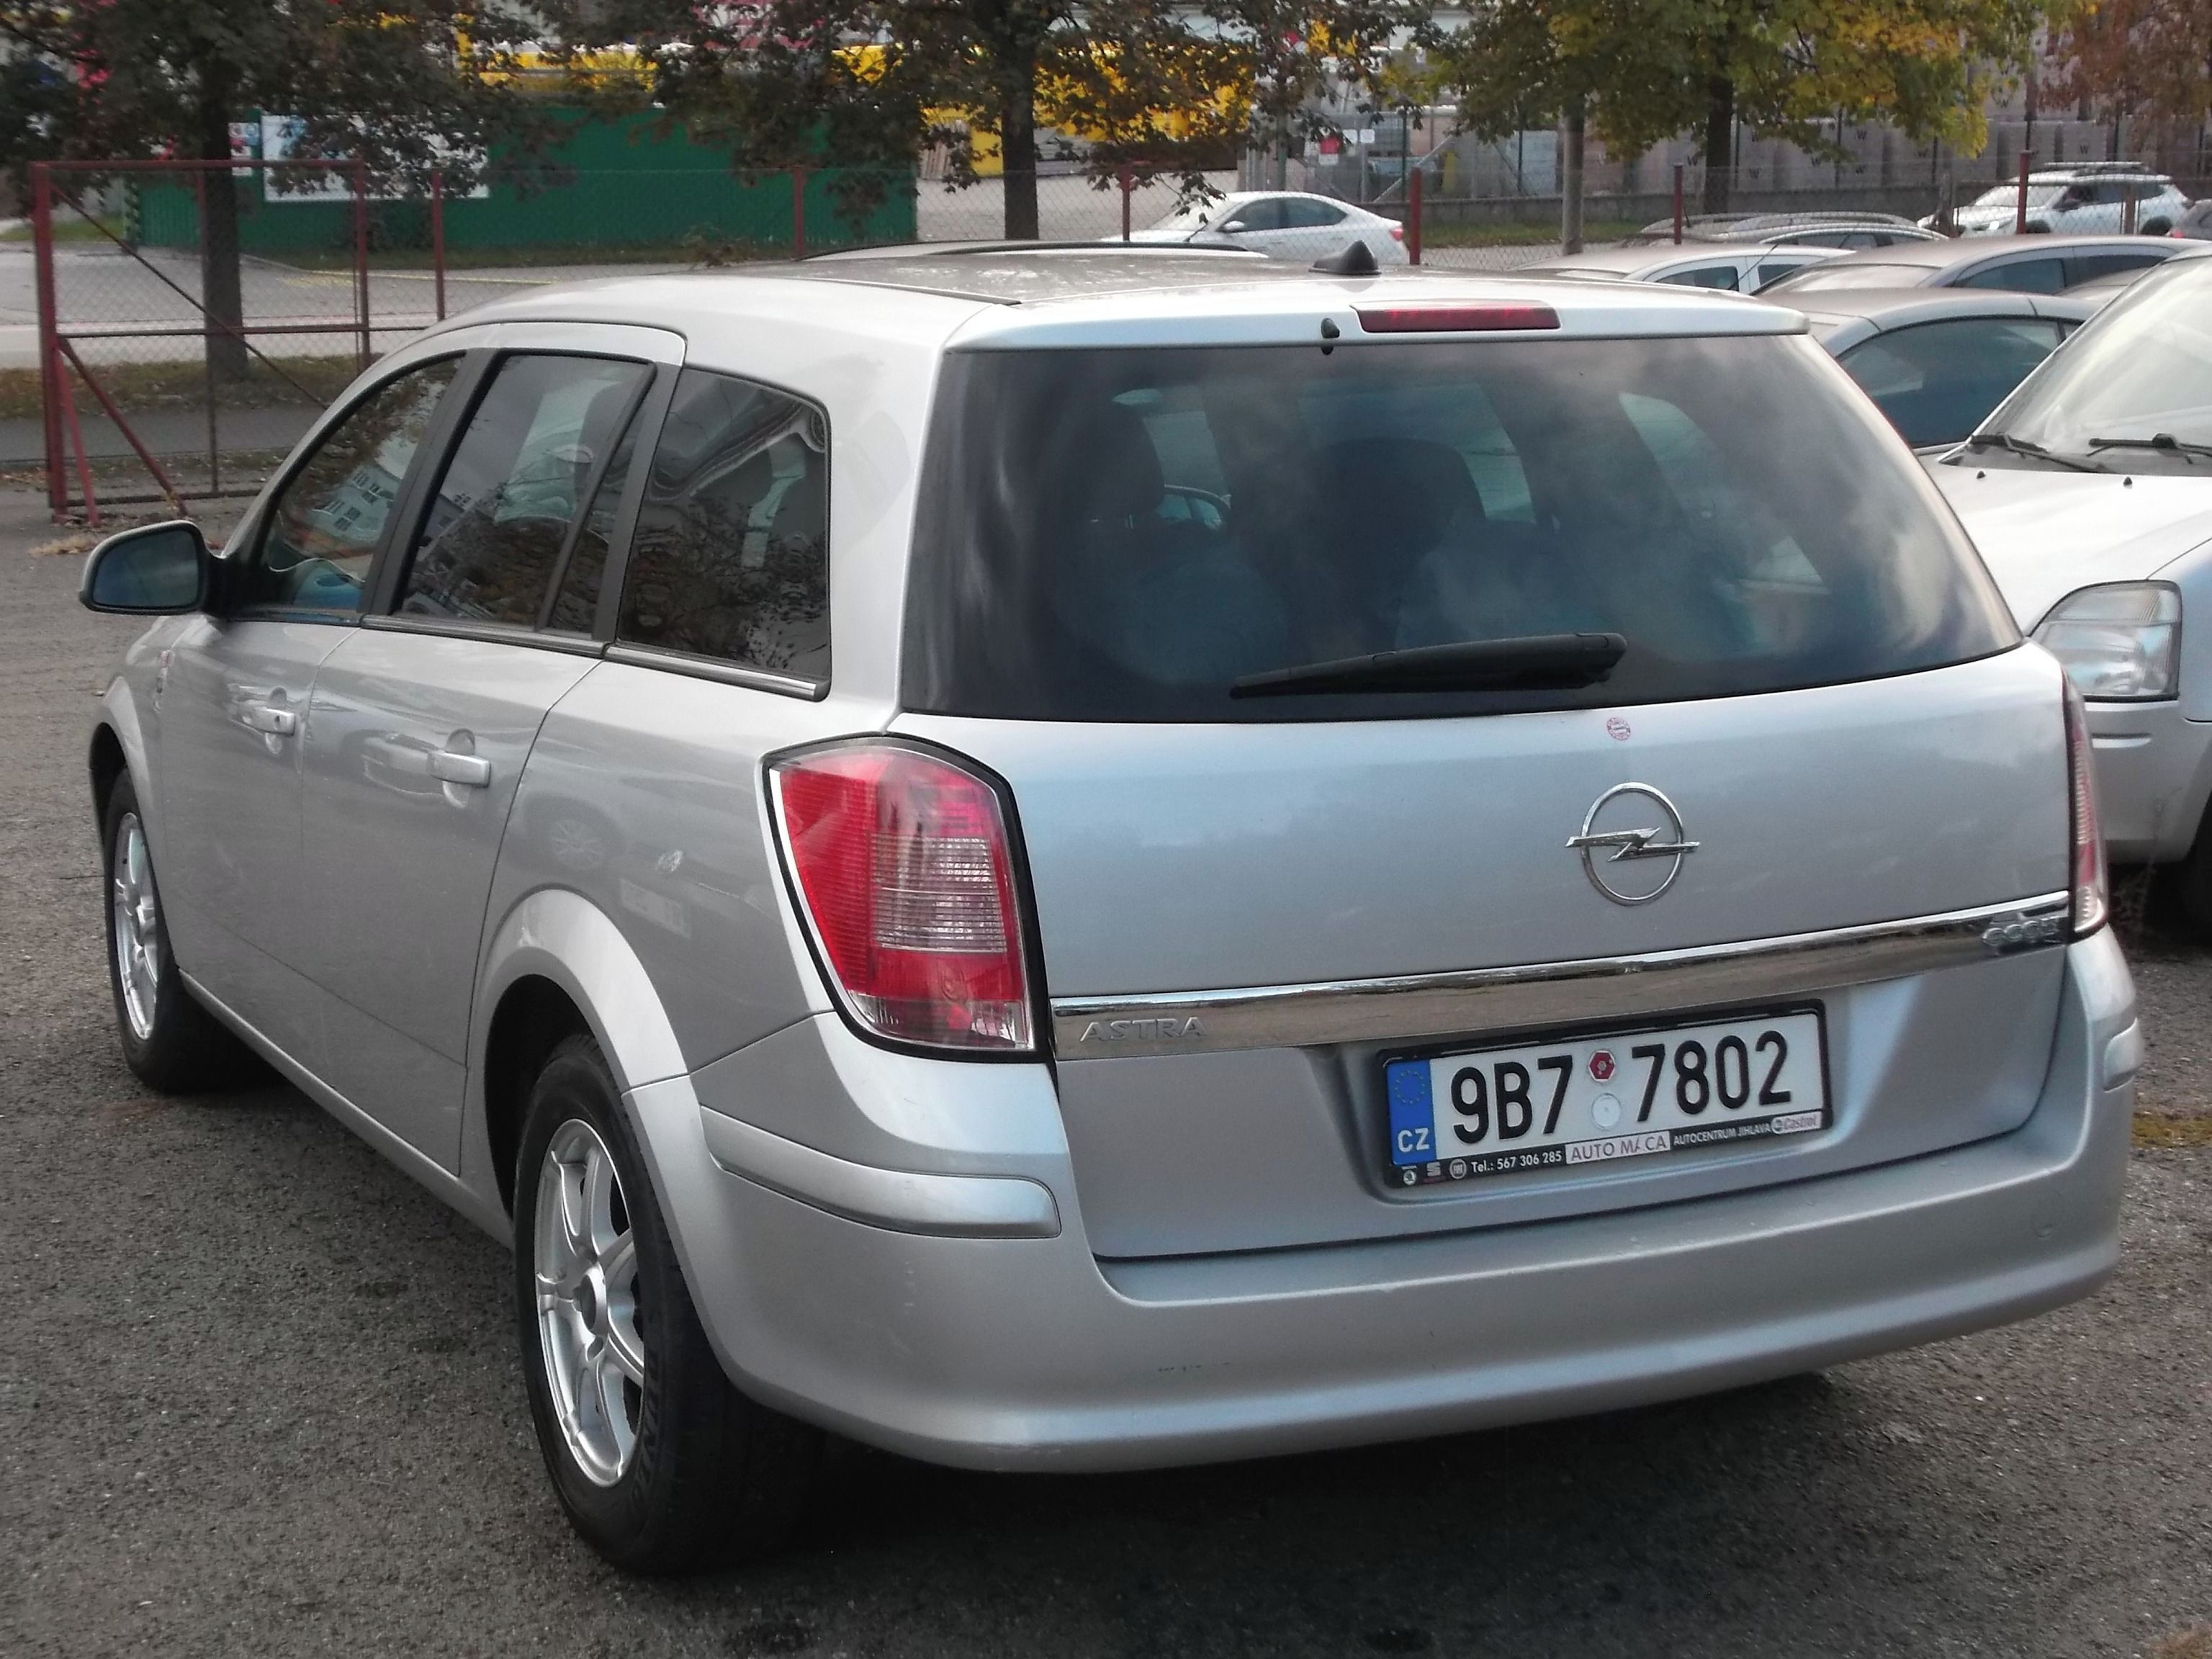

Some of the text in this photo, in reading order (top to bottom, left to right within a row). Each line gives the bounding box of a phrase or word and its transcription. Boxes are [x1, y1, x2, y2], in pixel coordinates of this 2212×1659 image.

[1080, 1017, 1208, 1042] ASTRA
[1450, 1030, 1791, 1144] 9B7 7802
[1398, 1128, 1429, 1152] CZ
[1673, 1123, 1771, 1146] AUTOCENTRUM JIHLAVA
[1471, 1151, 1562, 1172] Tel.: 567 306 285
[1571, 1142, 1615, 1161] AUTO
